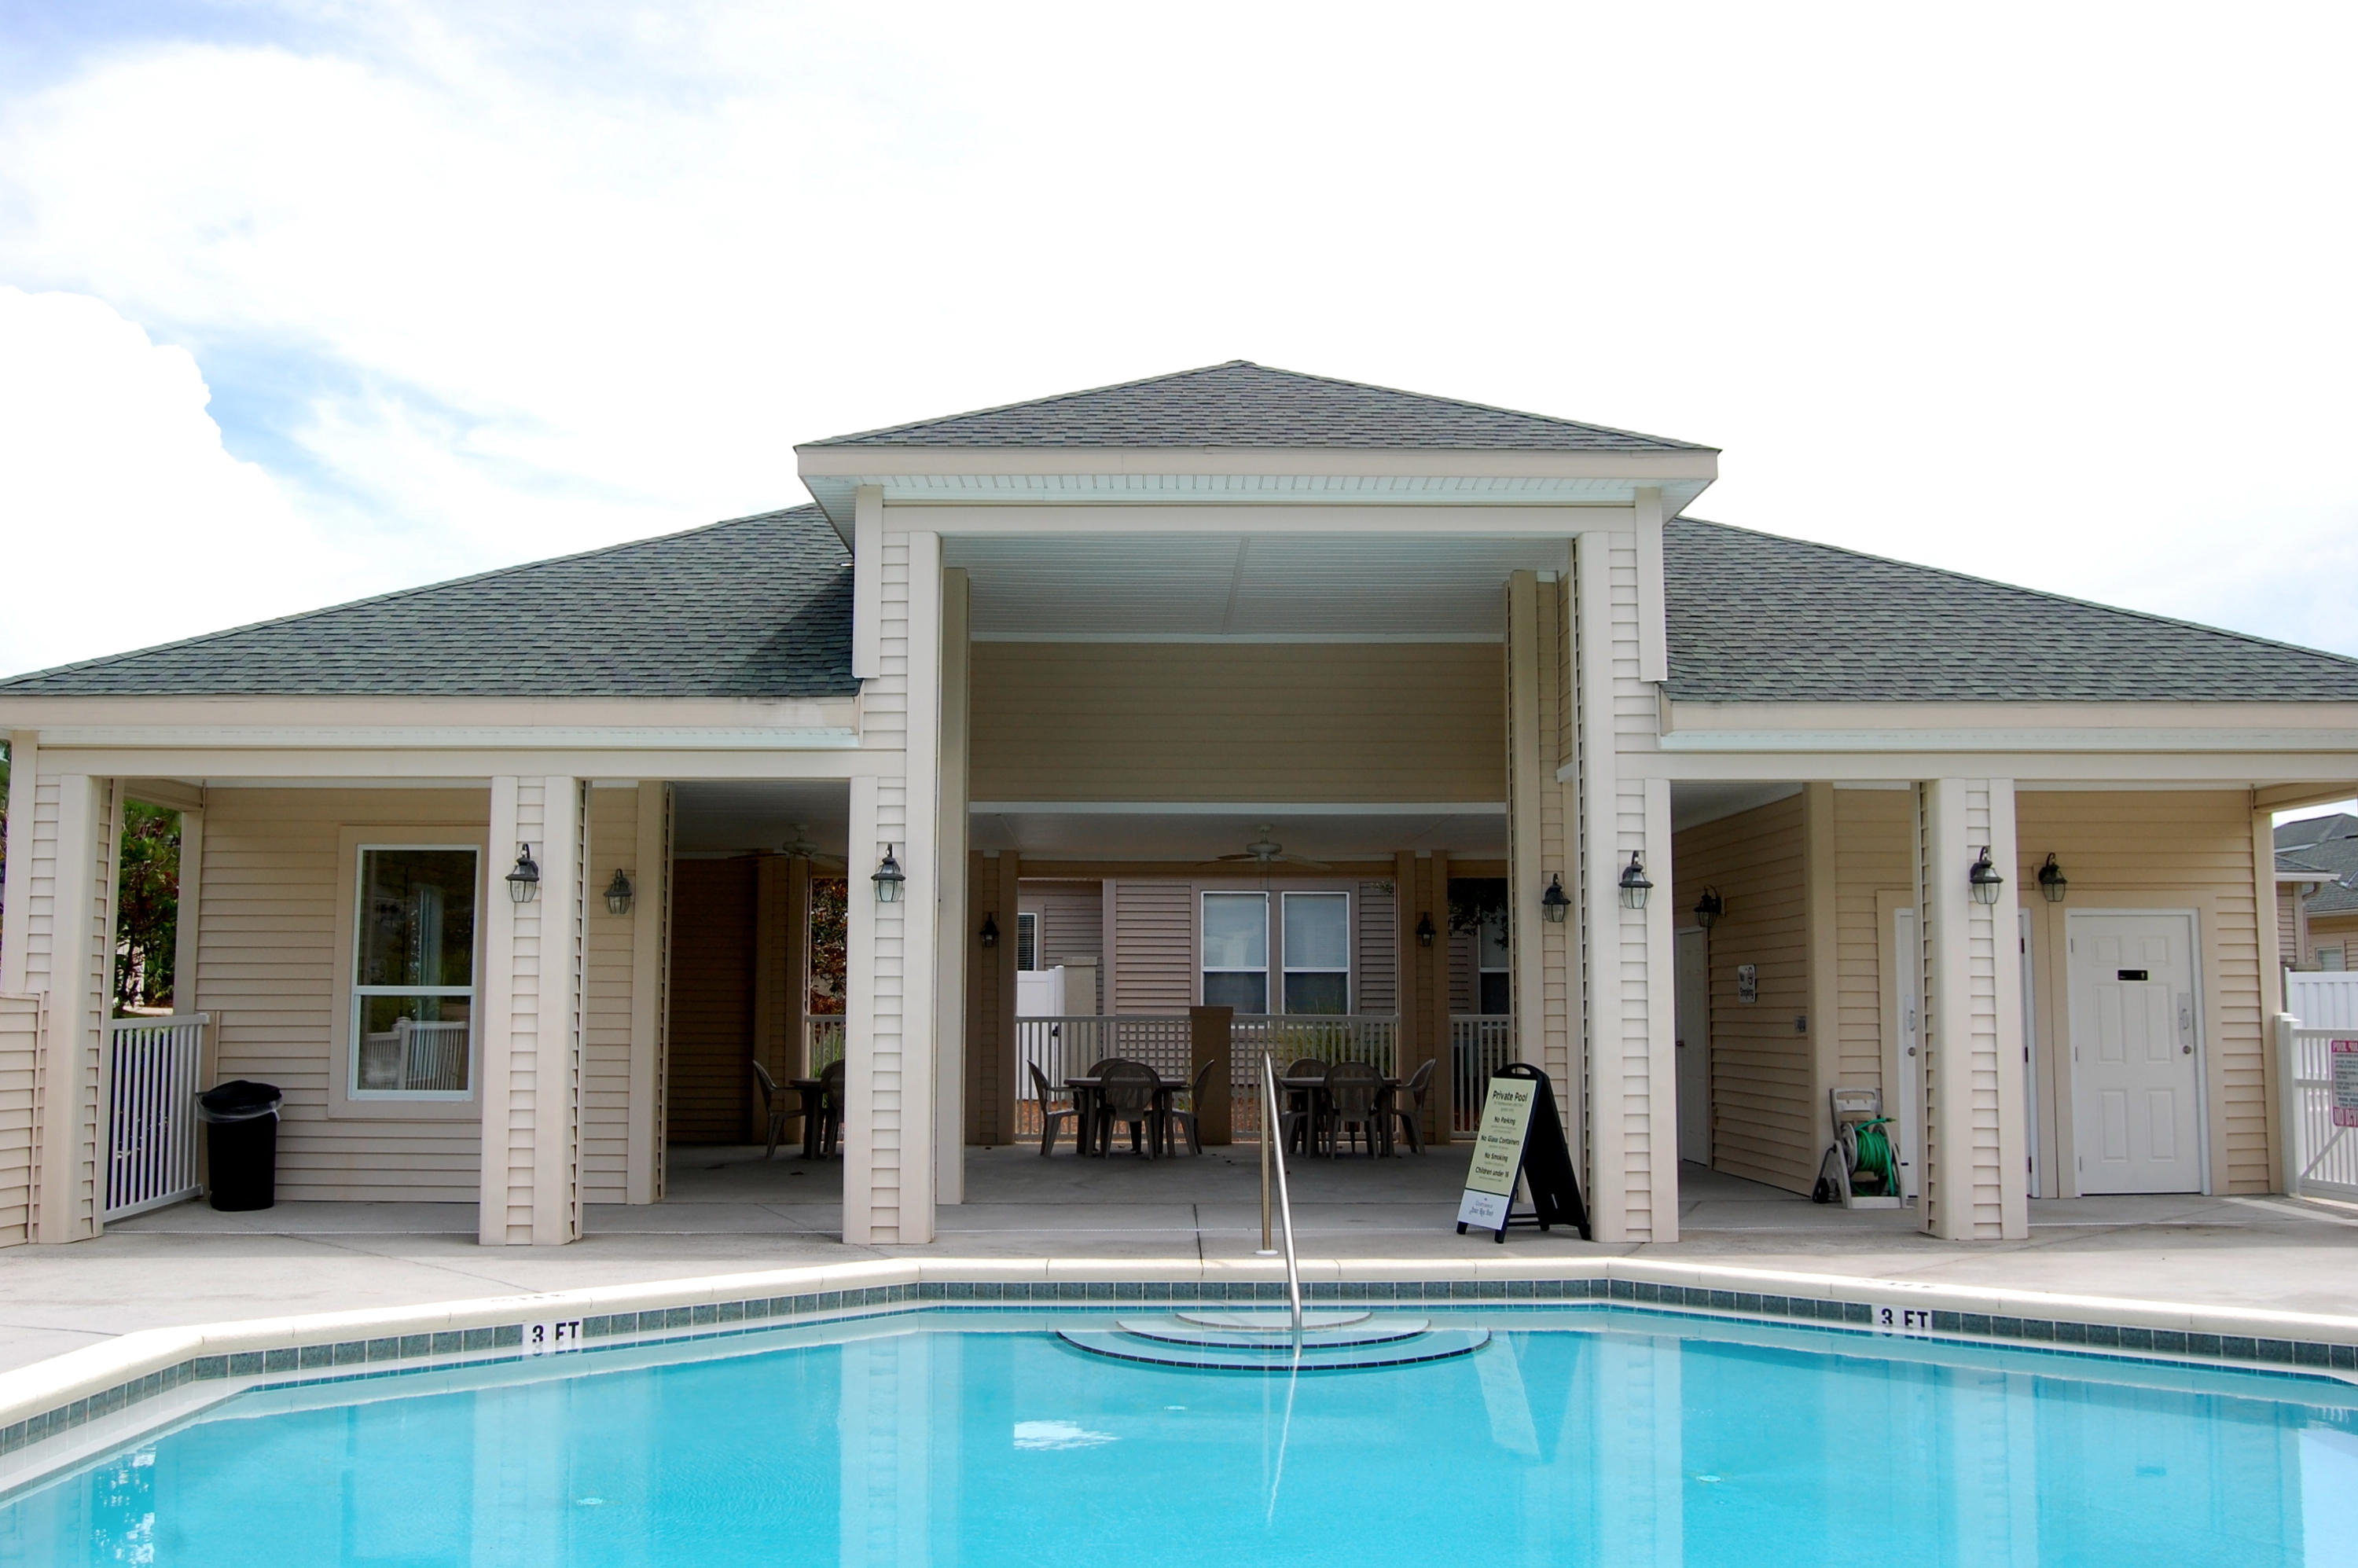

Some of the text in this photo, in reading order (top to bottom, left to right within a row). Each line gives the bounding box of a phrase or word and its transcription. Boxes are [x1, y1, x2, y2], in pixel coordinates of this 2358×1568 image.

[1739, 986, 1754, 1000] Smoking
[1493, 1089, 1528, 1102] Private Pool
[1501, 1116, 1515, 1126] Parking
[1499, 1136, 1519, 1145] Containers
[1491, 1152, 1508, 1163] Smoking
[1475, 1166, 1492, 1175] Children
[1881, 1308, 1928, 1327] 3 FT
[532, 1321, 579, 1342] 3 FT
